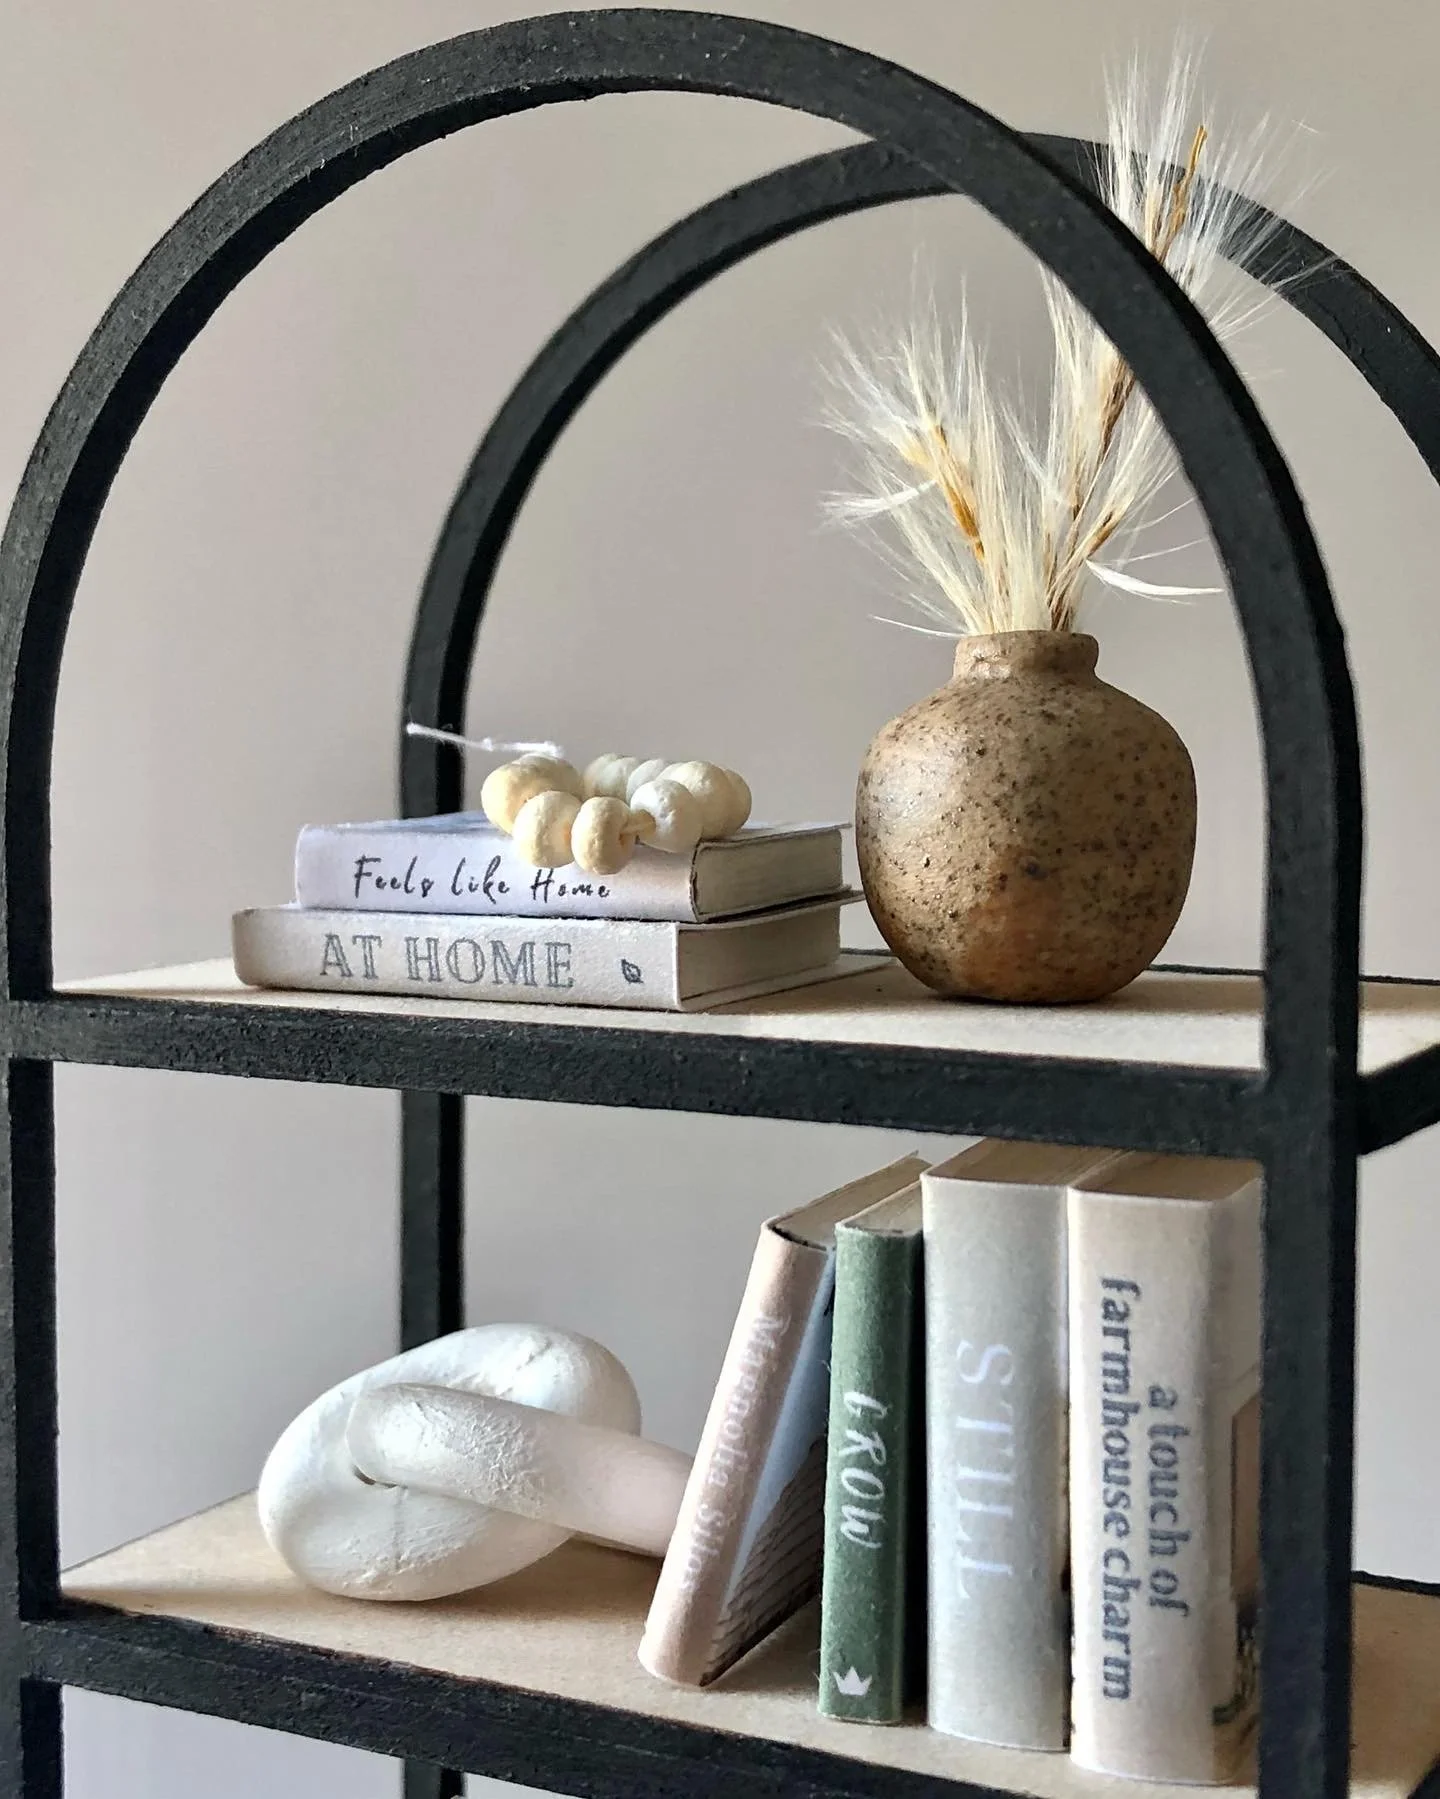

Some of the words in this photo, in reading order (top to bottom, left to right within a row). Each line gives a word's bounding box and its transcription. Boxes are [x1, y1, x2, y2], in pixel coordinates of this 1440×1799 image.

[353, 854, 435, 899] Feels
[530, 866, 611, 904] Home
[319, 932, 383, 980] AT
[403, 935, 576, 989] HOME
[704, 1311, 792, 1489] Magnolia
[1099, 1275, 1141, 1540] farmhouse
[1147, 1384, 1179, 1409] a
[954, 1338, 1017, 1601] STILL
[1146, 1420, 1191, 1558] touch
[1101, 1548, 1141, 1702] charm
[1148, 1568, 1190, 1618] of
